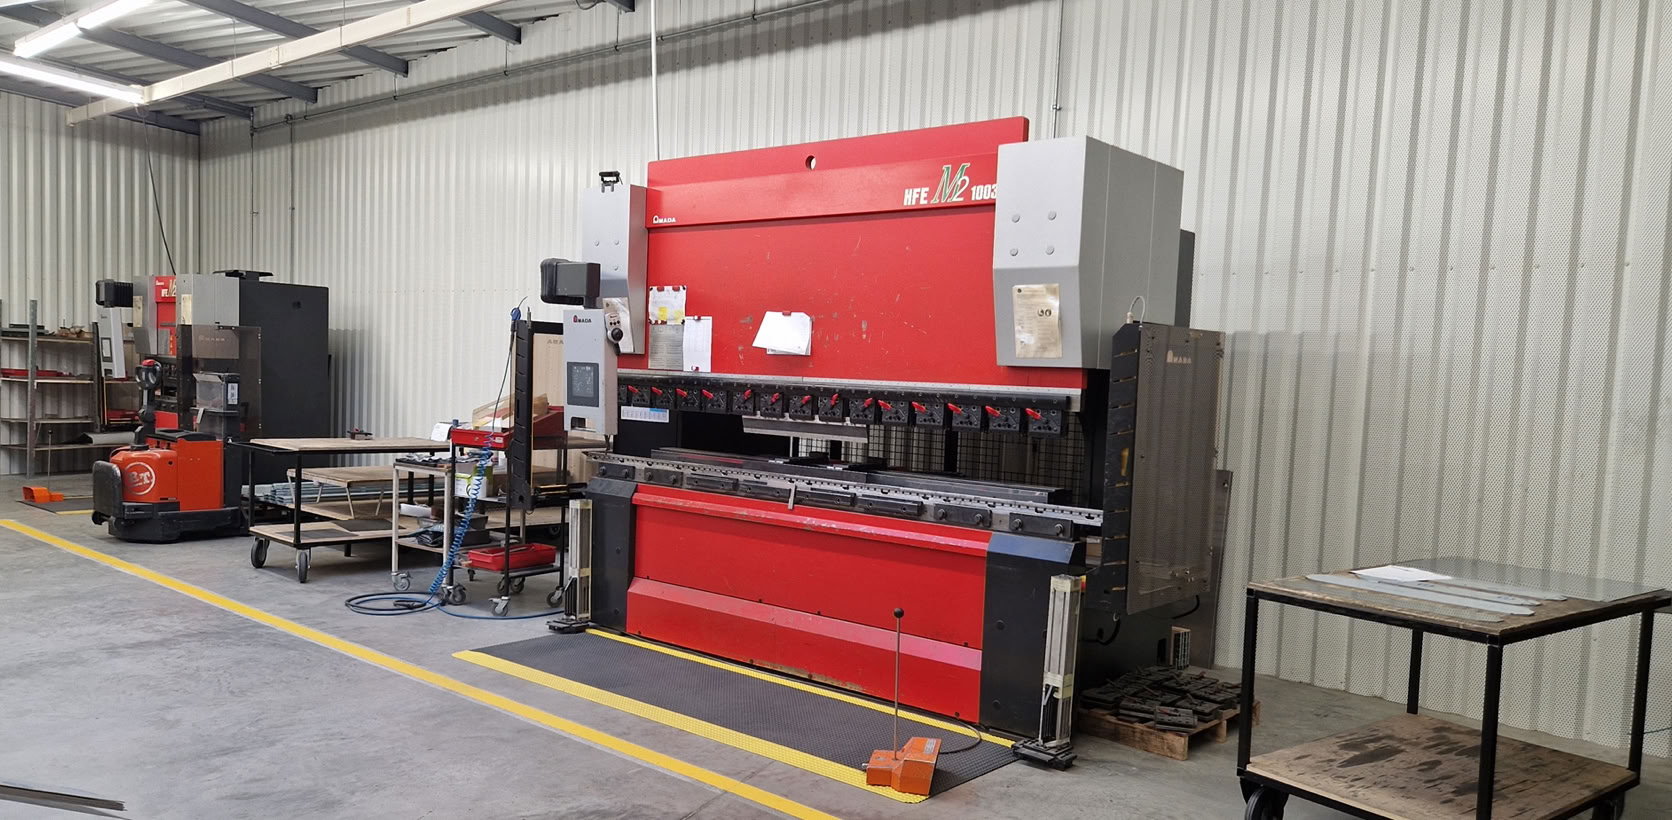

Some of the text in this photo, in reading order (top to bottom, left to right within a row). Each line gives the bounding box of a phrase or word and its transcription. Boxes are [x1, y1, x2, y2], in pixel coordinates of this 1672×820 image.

[903, 187, 929, 206] HFE
[970, 183, 997, 201] 1003
[652, 215, 677, 224] AMADA
[573, 315, 592, 323] AMADA
